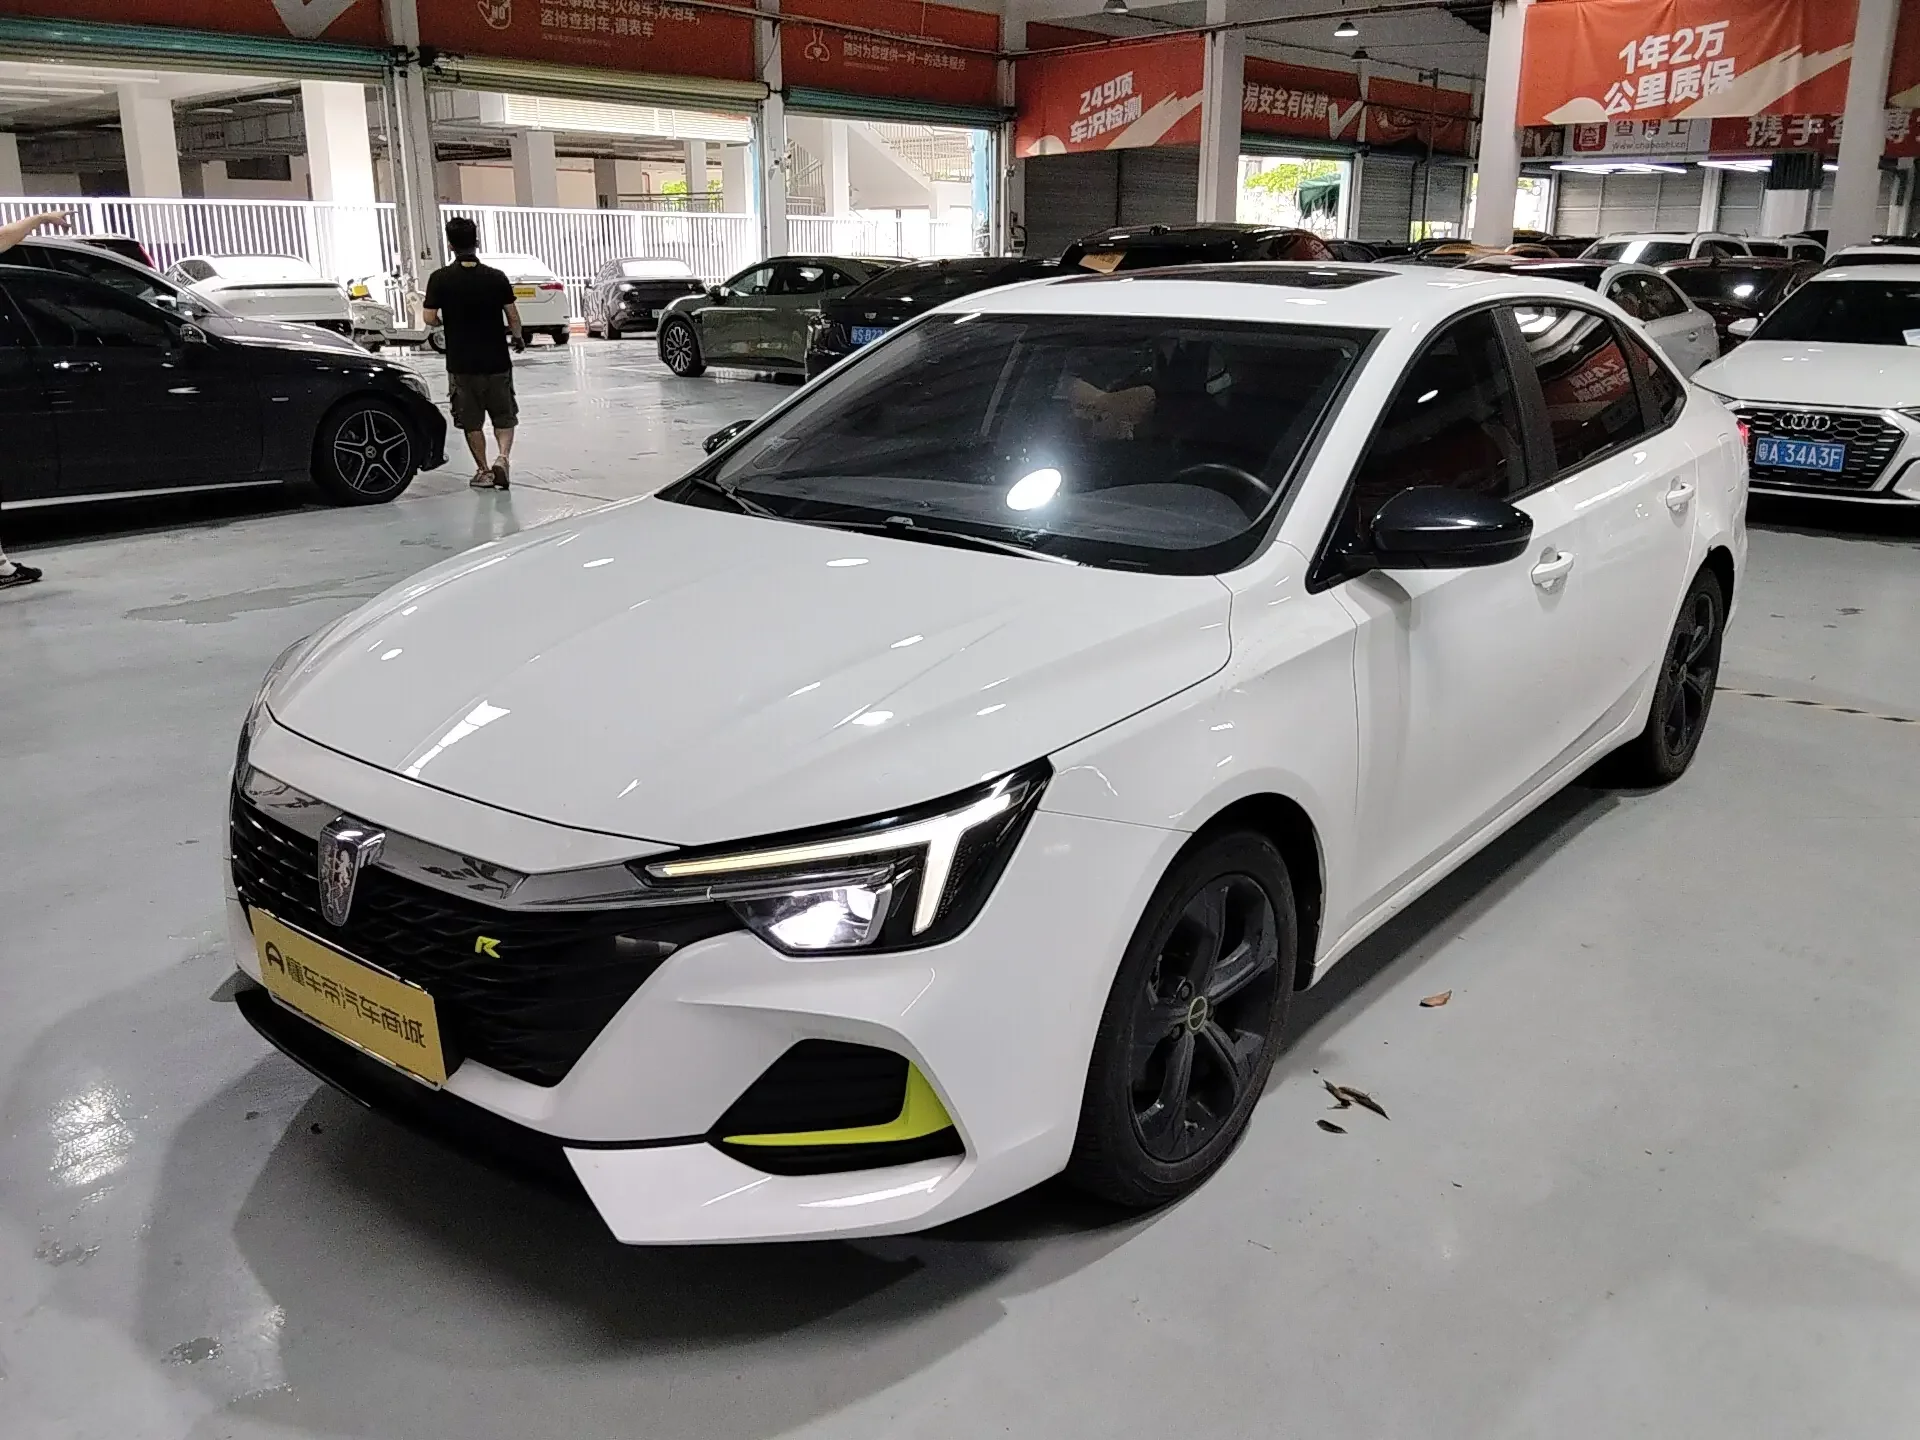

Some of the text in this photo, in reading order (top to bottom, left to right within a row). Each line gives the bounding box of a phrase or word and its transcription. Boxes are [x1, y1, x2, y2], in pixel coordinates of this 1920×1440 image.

[1618, 19, 1730, 75] 1年2万
[1079, 71, 1134, 115] 249项
[1241, 81, 1330, 121] 易安全有保障
[1603, 57, 1737, 116] 公里质保
[1069, 94, 1142, 144] 车况检测
[286, 956, 427, 1048] 懂车帝汽车商城
